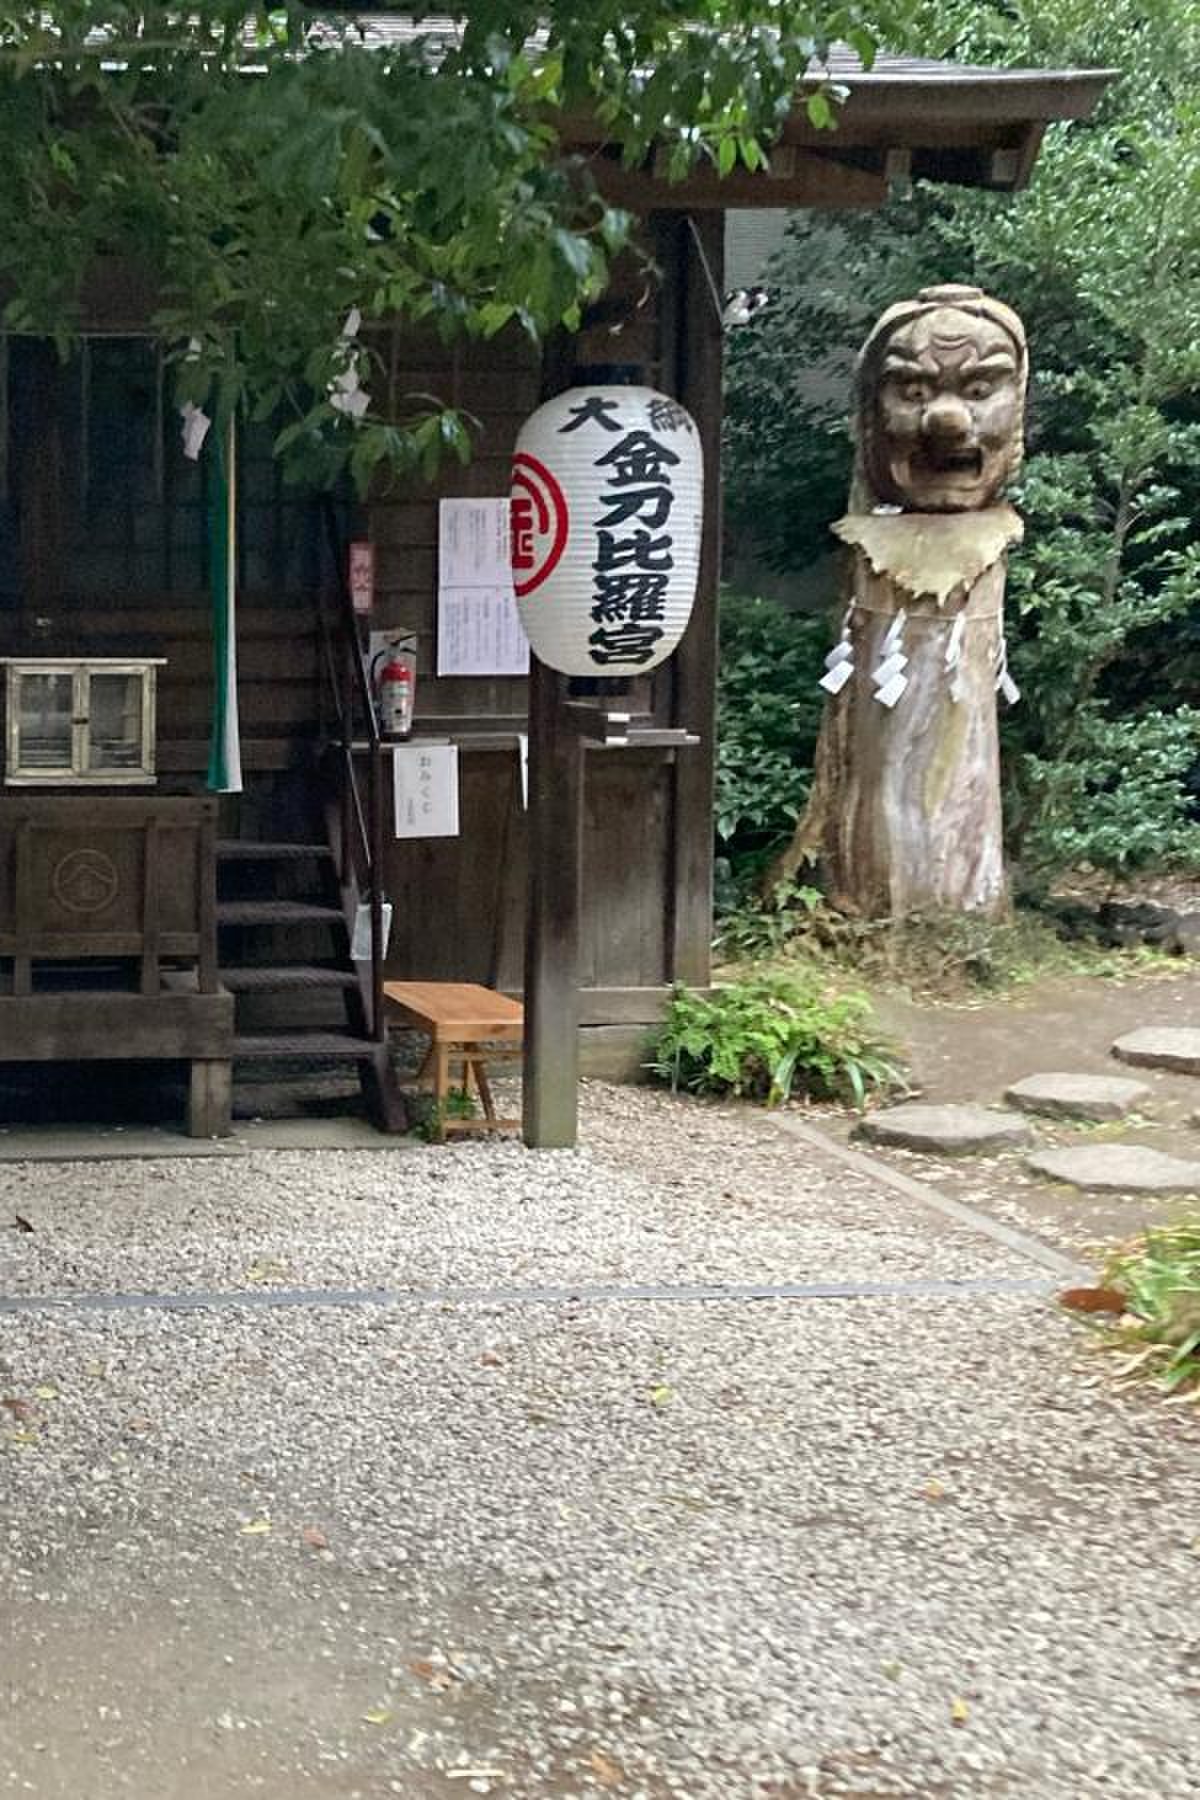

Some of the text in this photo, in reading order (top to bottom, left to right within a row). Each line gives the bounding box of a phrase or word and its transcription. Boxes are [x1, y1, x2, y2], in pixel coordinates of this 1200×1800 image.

[589, 430, 681, 665] 金刀比羅宮
